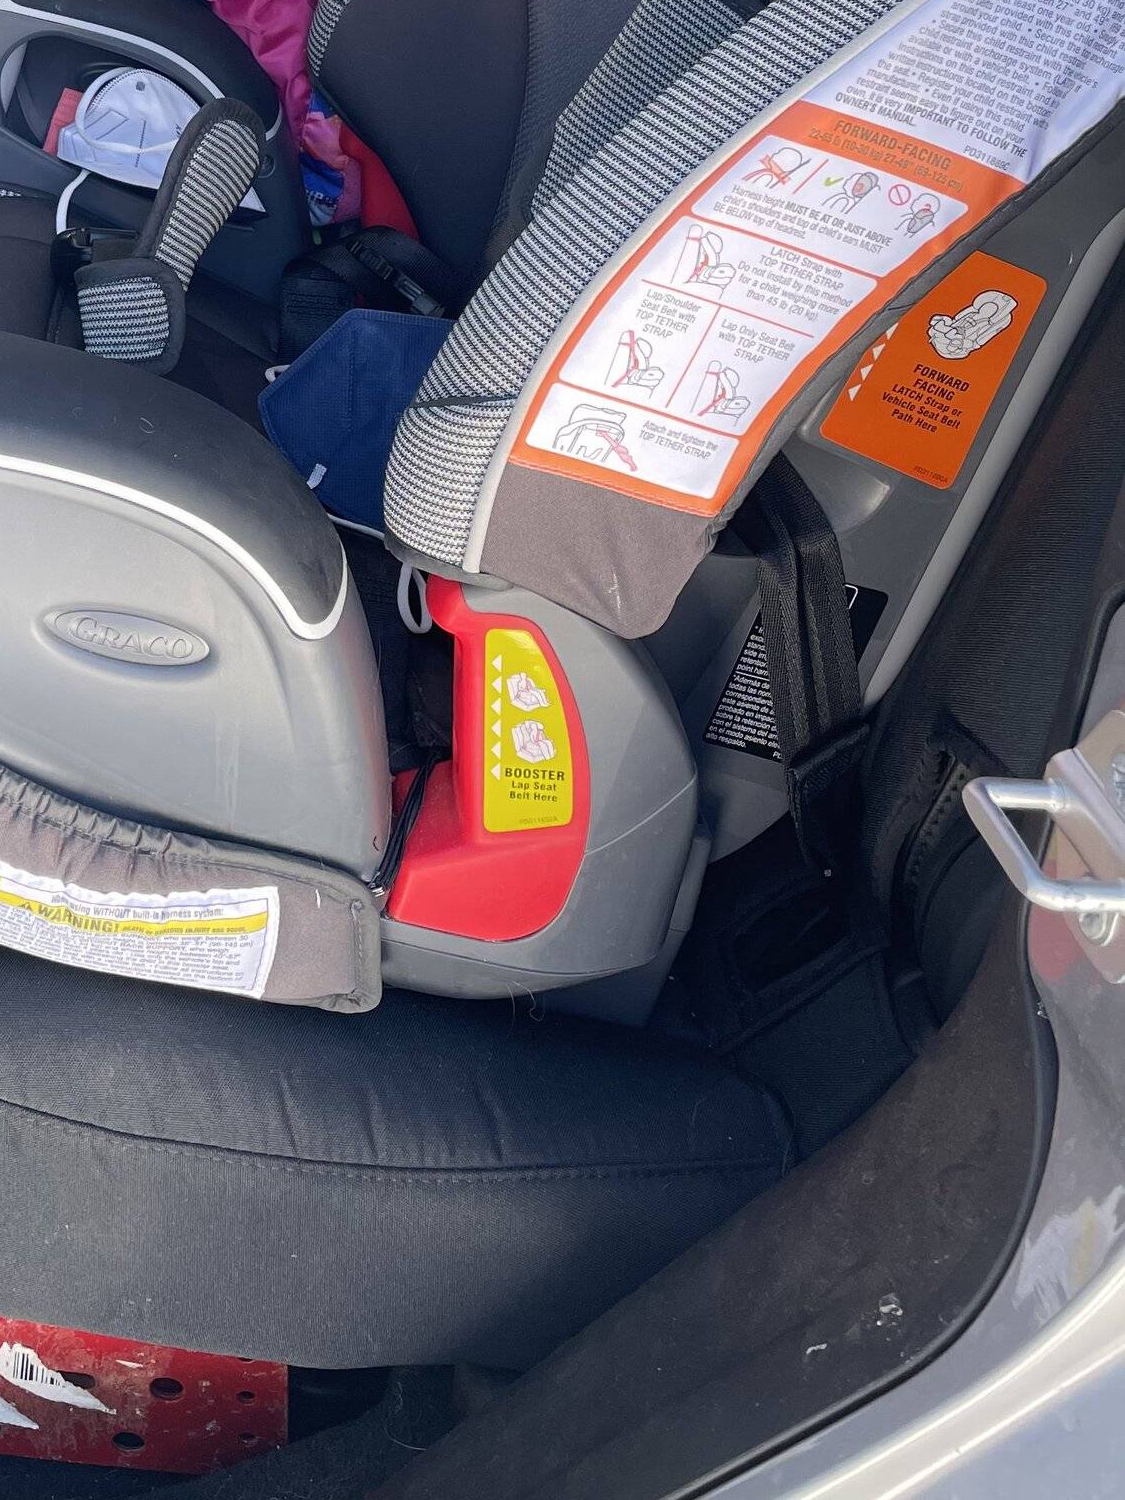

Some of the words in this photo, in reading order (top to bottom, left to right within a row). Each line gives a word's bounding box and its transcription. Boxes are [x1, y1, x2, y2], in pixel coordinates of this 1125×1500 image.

[994, 4, 1033, 24] provided
[1035, 17, 1053, 29] with
[1037, 8, 1052, 17] one
[1074, 7, 1091, 18] and
[1082, 0, 1095, 9] 30
[1034, 30, 1058, 44] Secure
[1035, 43, 1057, 56] child
[972, 45, 1018, 67] anchorage
[1018, 61, 1052, 80] system
[984, 36, 1005, 48] child
[1006, 44, 1041, 62] restraint
[1042, 58, 1061, 70] with
[945, 61, 956, 69] on
[958, 64, 974, 74] this
[975, 70, 995, 82] child
[996, 78, 1032, 96] restraint
[835, 92, 876, 112] OWNER'S
[965, 78, 995, 94] located
[996, 91, 1008, 99] on
[1010, 95, 1025, 105] the
[931, 90, 951, 102] Even
[985, 110, 1001, 121] this
[1003, 117, 1024, 131] child
[940, 105, 949, 113] to
[975, 118, 990, 128] out
[991, 126, 1003, 134] on
[973, 93, 994, 106] child
[995, 102, 1031, 122] restraint
[903, 104, 955, 128] IMPORTANT
[955, 122, 968, 133] TO
[969, 128, 1009, 149] FOLLOW
[1010, 144, 1026, 157] THE
[834, 119, 951, 169] FORWARD-FACING
[714, 202, 724, 211] BE
[725, 206, 751, 219] BELOW
[785, 201, 808, 215] MUST
[809, 209, 820, 219] BE
[820, 213, 831, 223] AT
[831, 217, 844, 227] OR
[844, 222, 865, 235] JUST
[865, 229, 892, 246] ABOVE
[760, 256, 778, 268] TOP
[779, 262, 812, 279] TETHER
[813, 274, 843, 290] STRAP
[770, 247, 800, 262] LATCH
[800, 258, 823, 272] Strap
[825, 266, 842, 277] with
[738, 261, 750, 270] Do
[752, 266, 765, 276] not
[791, 280, 802, 291] by
[804, 285, 819, 295] this
[820, 291, 851, 307] method
[739, 274, 750, 283] for
[641, 299, 659, 310] Seat
[678, 311, 695, 322] with
[646, 289, 701, 314] Lap/Shoulder
[766, 296, 777, 305] 45
[779, 300, 787, 308] lb
[788, 304, 803, 315] (20
[635, 309, 653, 320] TOP
[655, 315, 688, 331] TETHER
[643, 324, 672, 339] STRAP
[721, 319, 737, 332] Lap
[738, 325, 758, 339] Only
[759, 332, 777, 344] Seat
[718, 331, 735, 342] with
[737, 338, 755, 349] TOP
[757, 344, 789, 360] TETHER
[734, 348, 763, 363] STRAP
[913, 364, 969, 391] FORWARD
[913, 378, 955, 400] FACING
[881, 392, 916, 410] Vehicle
[917, 406, 939, 420] Seat
[940, 415, 960, 428] Belt
[892, 384, 923, 401] LATCH
[924, 396, 950, 413] Strap
[951, 408, 961, 416] or
[891, 409, 913, 422] Path
[915, 418, 937, 431] Here
[639, 431, 654, 441] TOP
[655, 436, 683, 450] TETHER
[684, 445, 710, 459] STRAP
[70, 615, 195, 662] GRACO
[505, 768, 564, 780] BOOSTER
[512, 781, 529, 790] Lap
[510, 791, 530, 799] Belt
[534, 793, 556, 801] Here
[37, 904, 118, 933] WARNING!
[93, 906, 129, 918] WITHOUT
